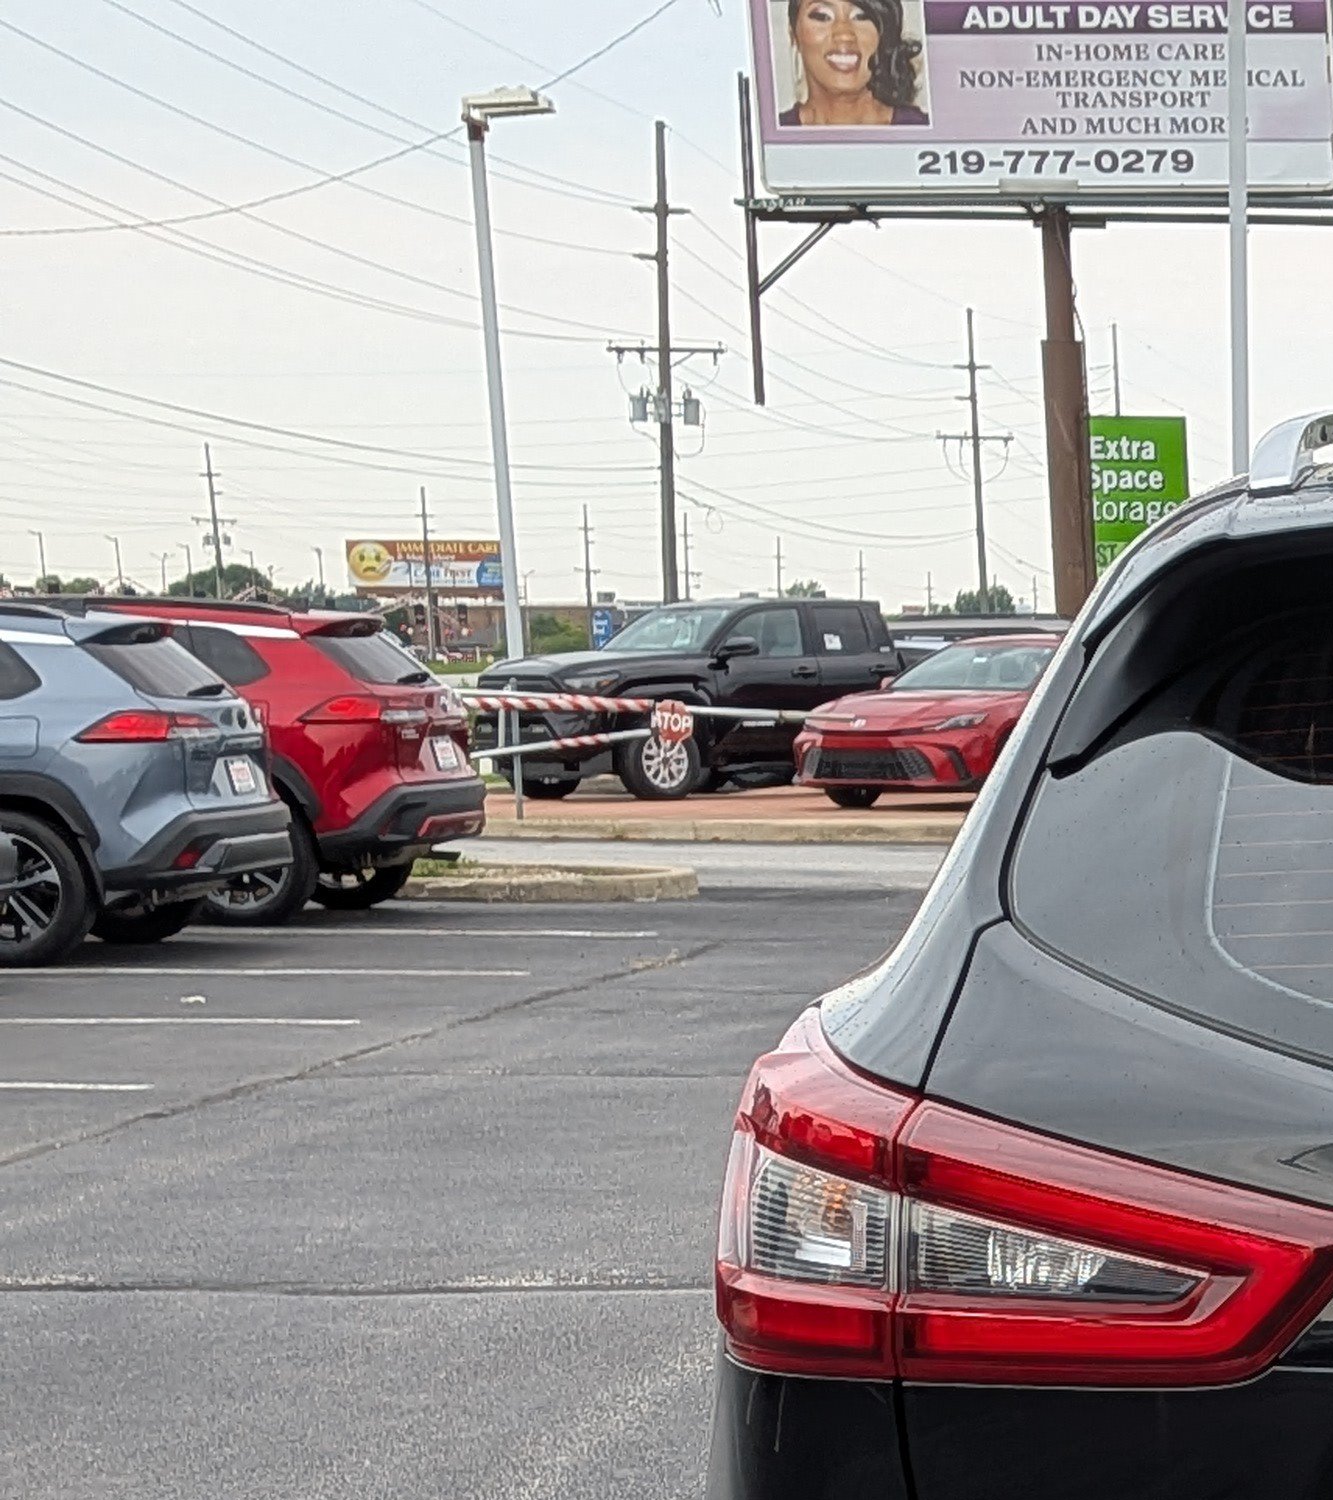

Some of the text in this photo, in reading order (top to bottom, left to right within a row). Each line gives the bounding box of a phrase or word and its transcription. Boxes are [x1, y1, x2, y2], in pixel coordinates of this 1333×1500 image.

[962, 4, 1294, 29] ADULT DAY SERVCE
[1035, 43, 1226, 62] IN-HOME CARE
[959, 69, 1306, 89] NON-EMERGENCY MEICAL
[1055, 90, 1211, 109] TRANSPORT
[1021, 116, 1250, 136] AND MUCH MOR
[917, 149, 1195, 175] 219-777-0279
[1090, 435, 1157, 461] Extra
[396, 542, 465, 555] IMMDIATE
